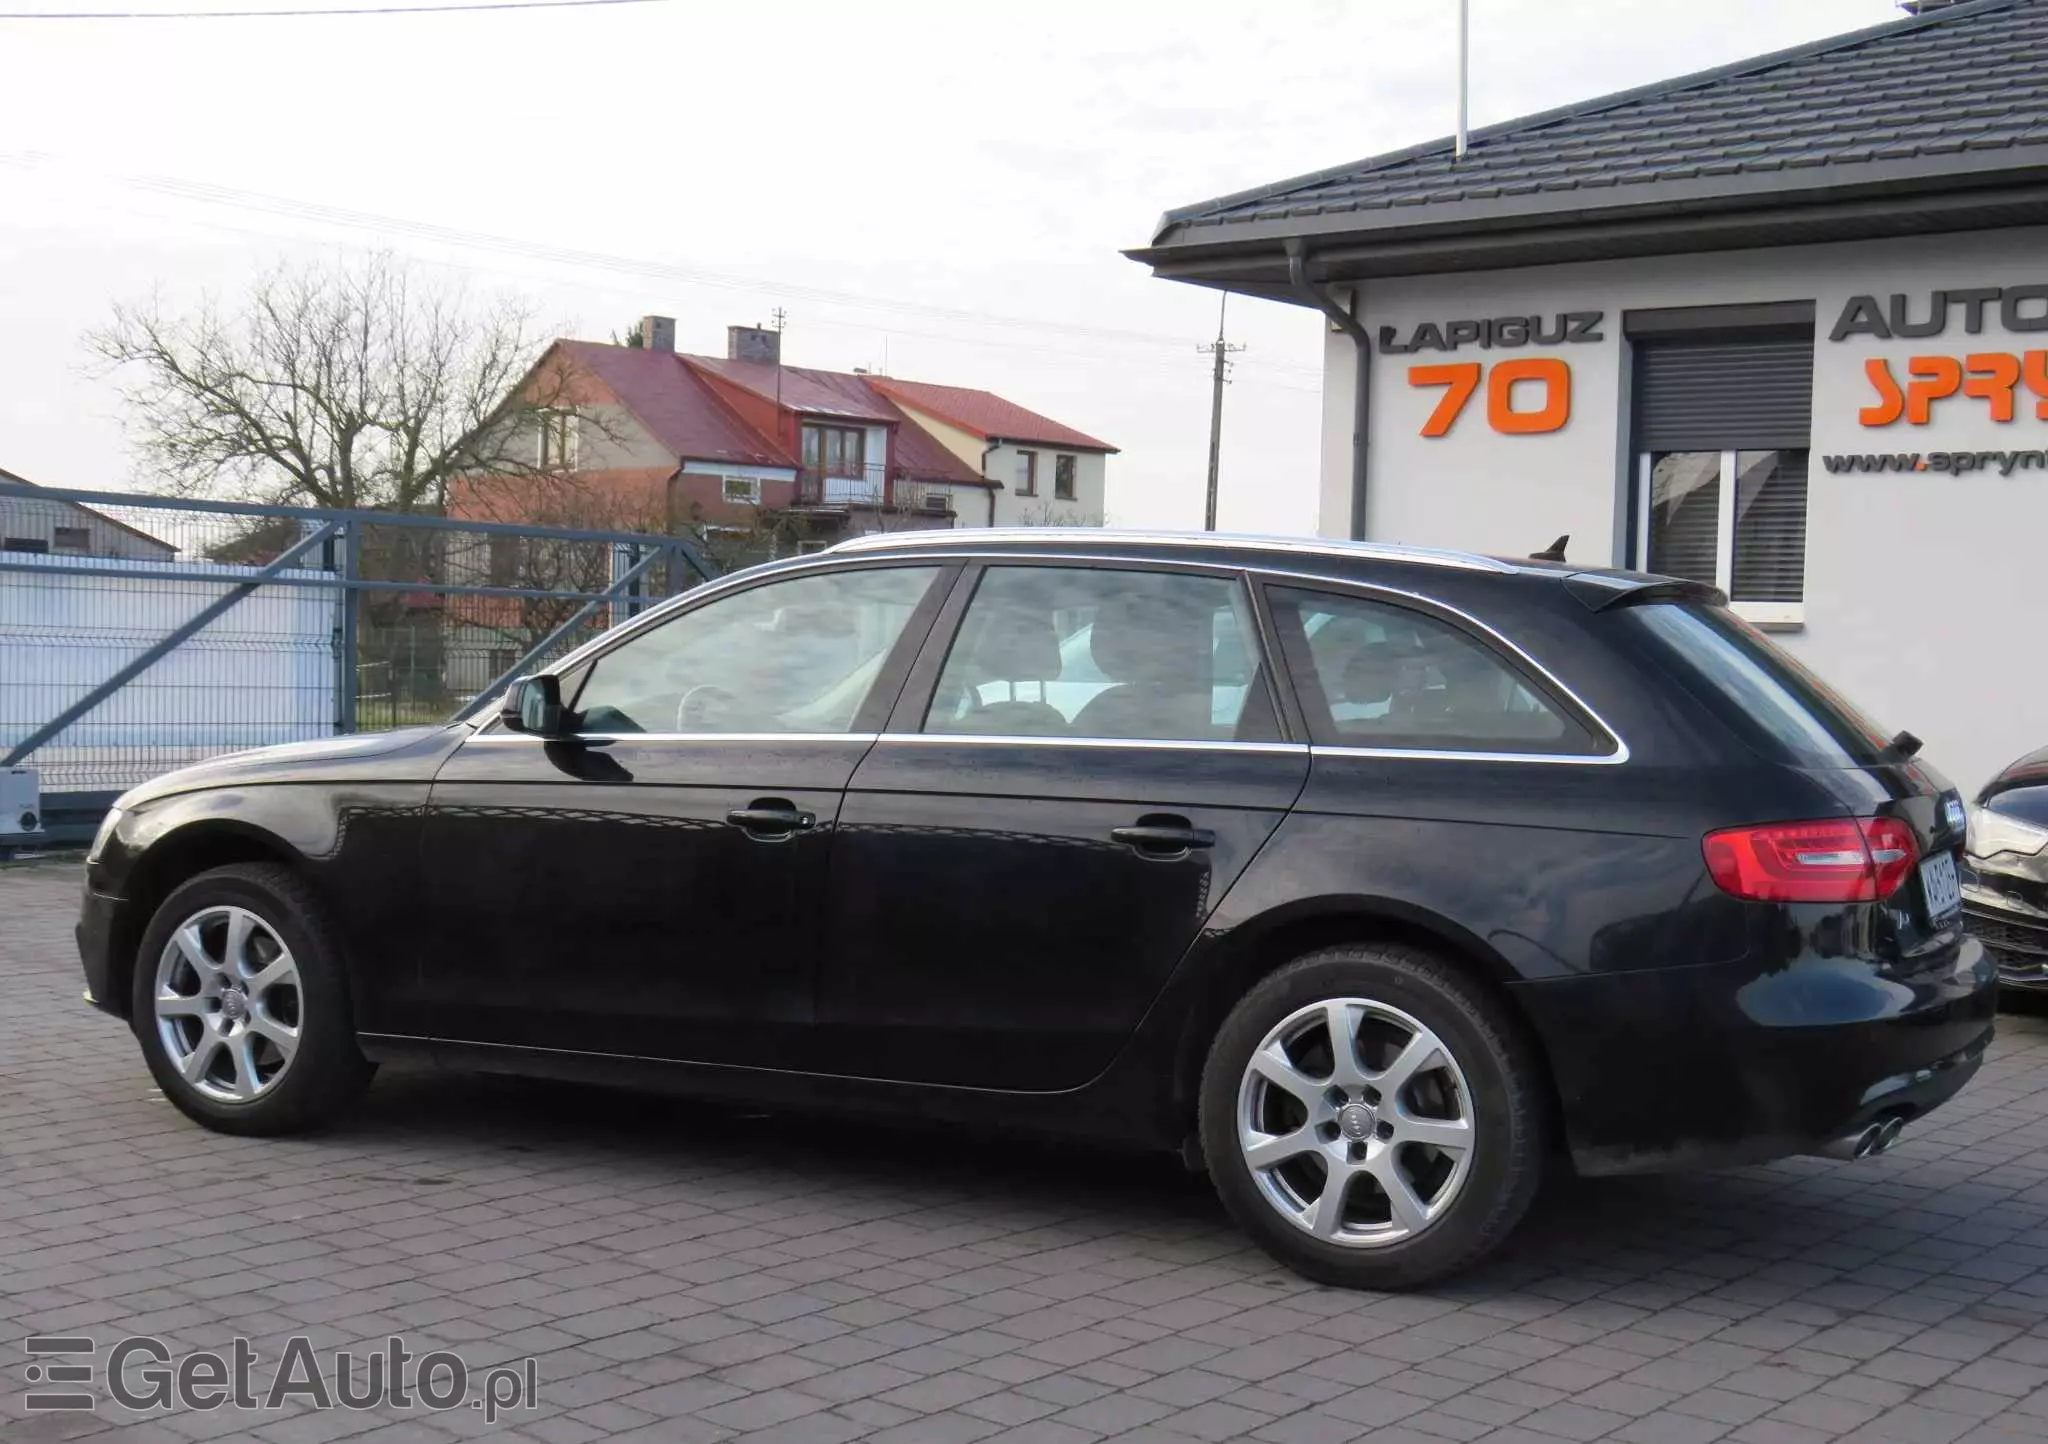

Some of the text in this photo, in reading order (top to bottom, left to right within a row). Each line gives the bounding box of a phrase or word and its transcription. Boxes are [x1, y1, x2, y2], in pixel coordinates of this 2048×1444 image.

[1828, 284, 2048, 342] AUTO
[1408, 358, 1571, 437] 70
[1822, 450, 2048, 477] www.spryn
